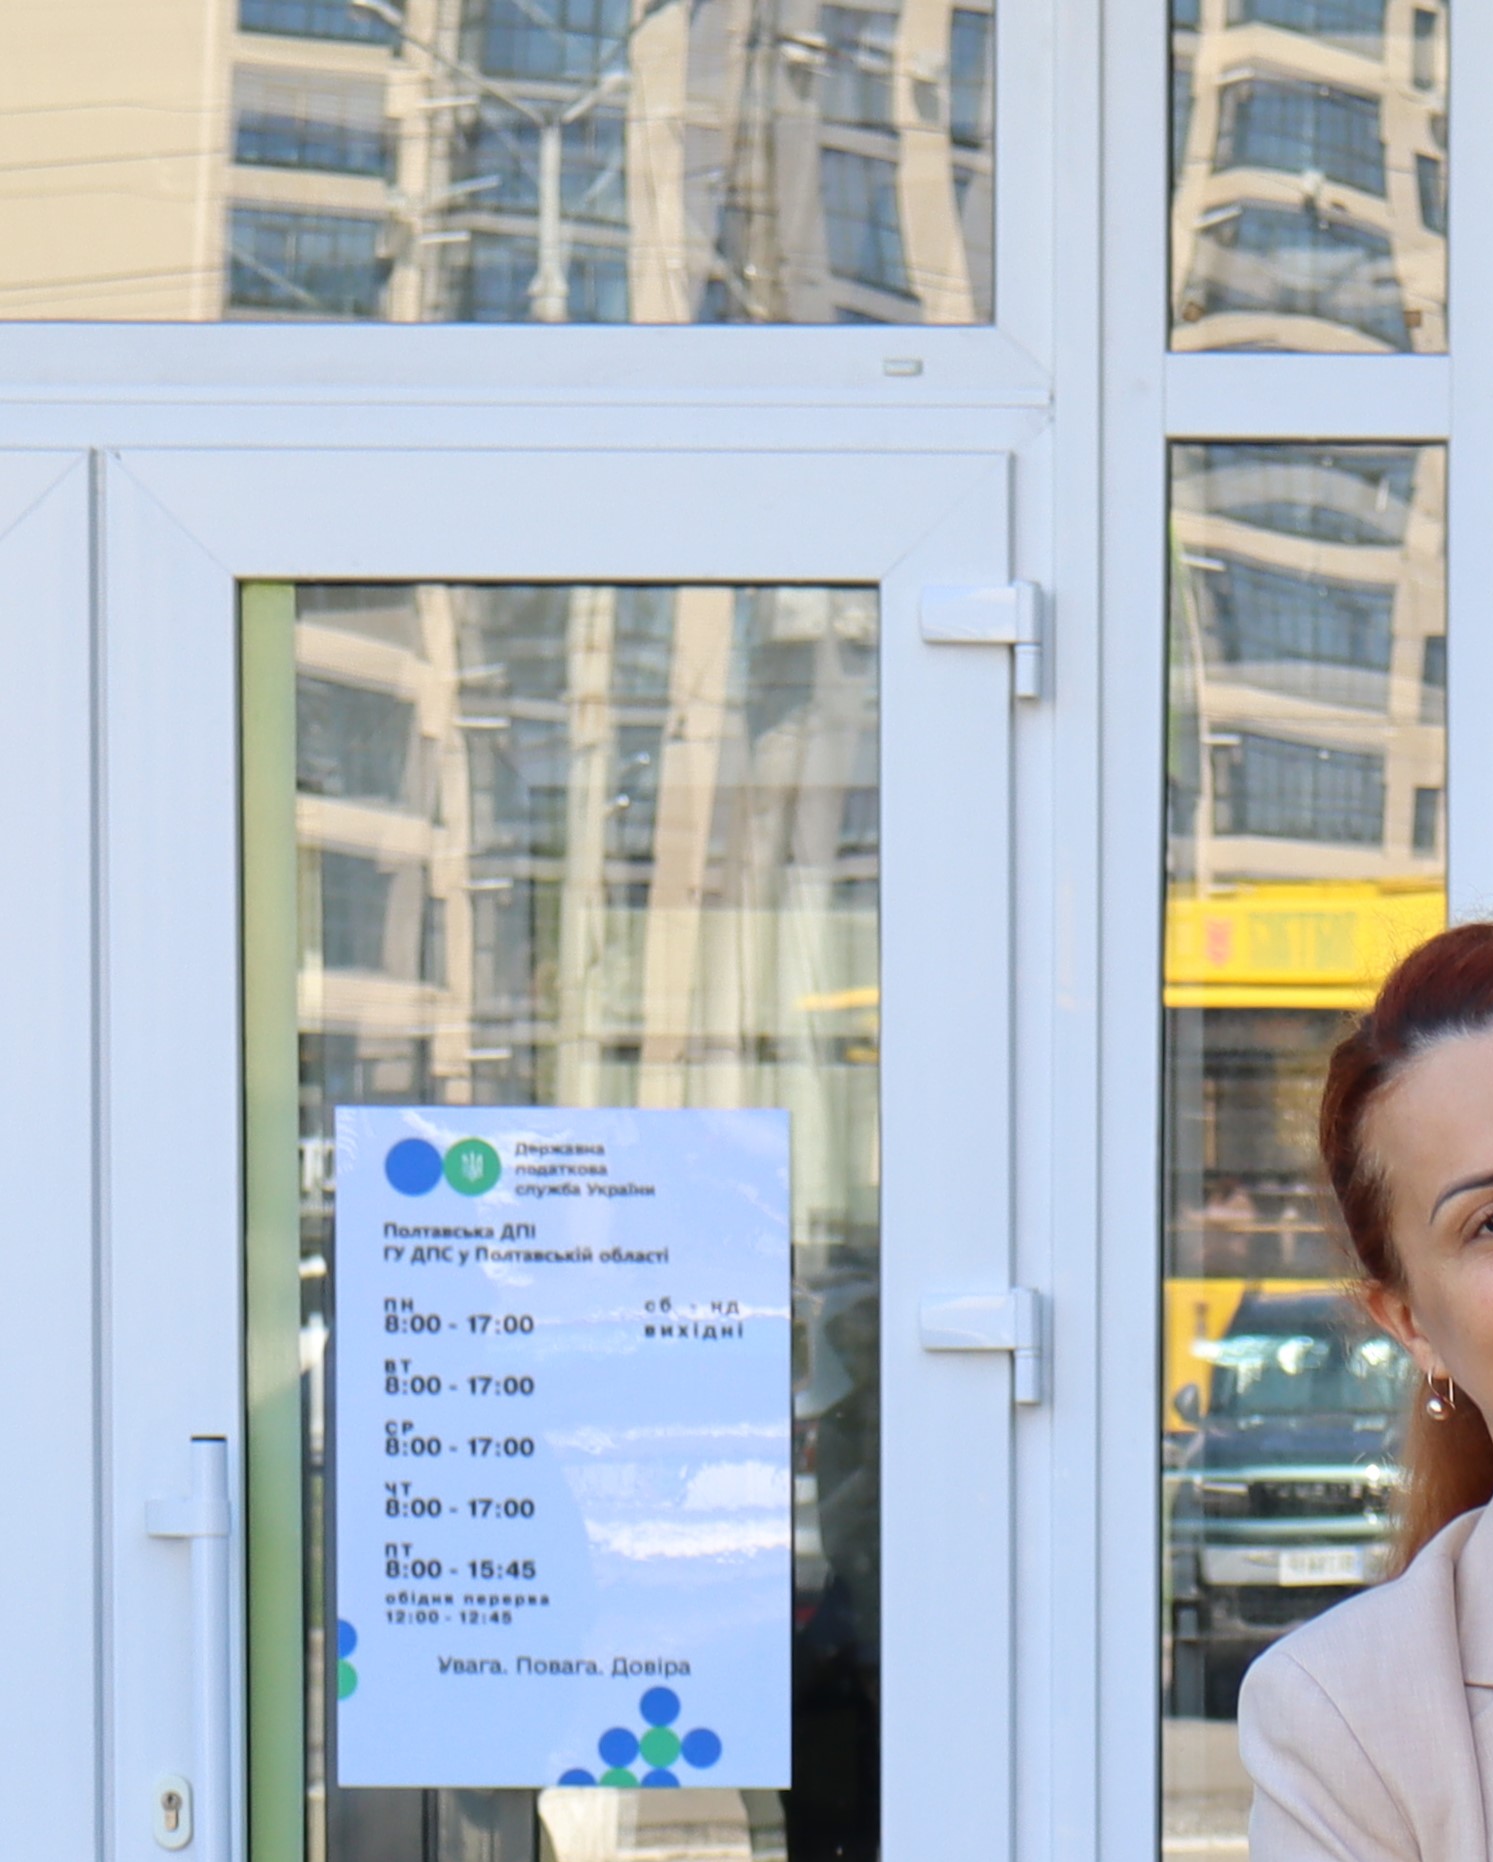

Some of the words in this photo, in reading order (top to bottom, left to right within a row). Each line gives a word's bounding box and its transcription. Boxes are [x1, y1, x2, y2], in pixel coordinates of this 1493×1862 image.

[515, 1143, 605, 1157] Державна
[515, 1165, 608, 1177] податкова
[515, 1183, 581, 1199] служба
[587, 1183, 655, 1198] України
[383, 1222, 494, 1239] Полтавська
[500, 1223, 536, 1242] ДПІ
[384, 1246, 405, 1262] ГУ
[410, 1246, 452, 1265] ДПС
[459, 1251, 469, 1266] у
[475, 1246, 593, 1263] Полтавській
[599, 1247, 669, 1264] області
[385, 1314, 441, 1334] 8:00
[468, 1314, 534, 1334] 17:00
[385, 1375, 442, 1395] 8:00
[468, 1376, 535, 1396] 17:00
[385, 1436, 442, 1457] 8:00
[468, 1437, 535, 1457] 17:00
[385, 1498, 442, 1518] 8:00
[469, 1499, 535, 1519] 17:00
[386, 1559, 442, 1579] 8:00
[469, 1560, 536, 1580] 15:45
[385, 1592, 453, 1606] обідня
[464, 1595, 549, 1608] перерва
[386, 1609, 439, 1624] 12:00
[460, 1610, 512, 1625] 12:45
[438, 1656, 507, 1675] Увага.
[516, 1656, 603, 1675] Повага.
[611, 1657, 691, 1679] Довіра
